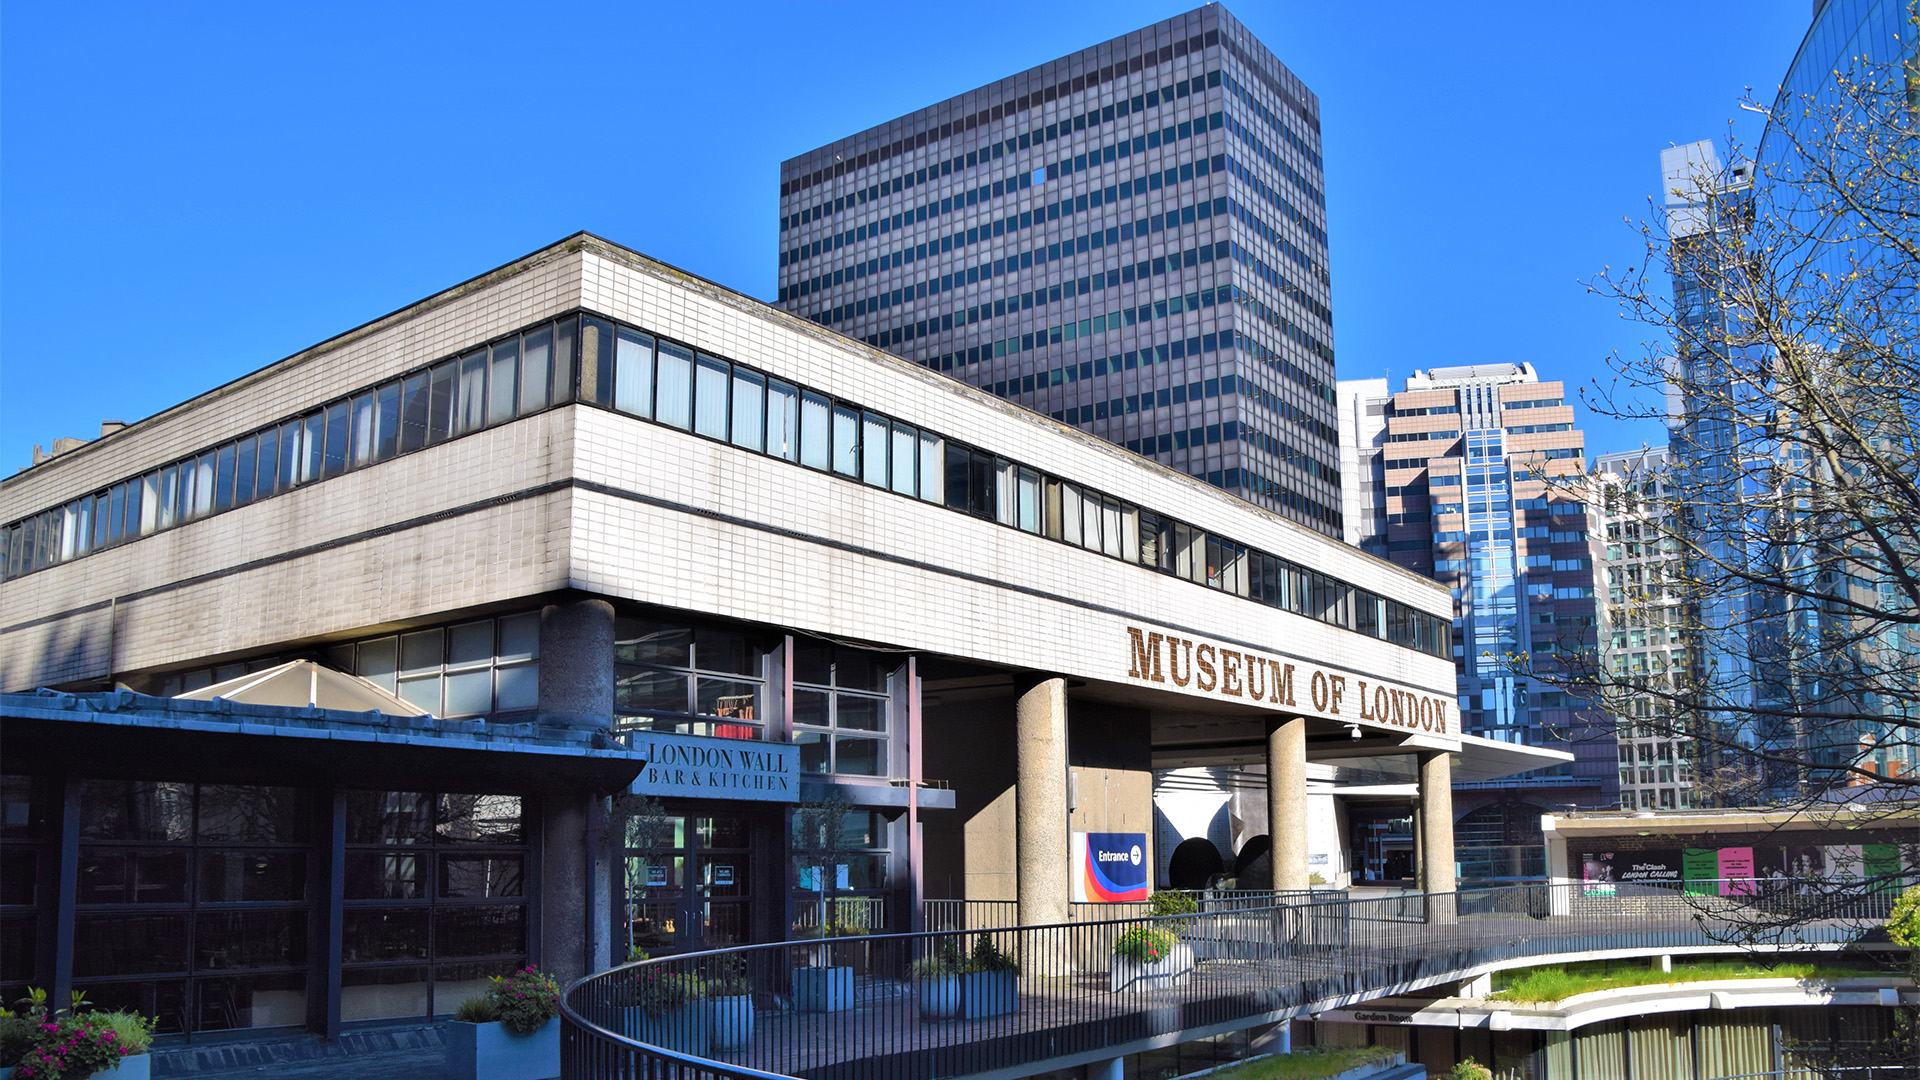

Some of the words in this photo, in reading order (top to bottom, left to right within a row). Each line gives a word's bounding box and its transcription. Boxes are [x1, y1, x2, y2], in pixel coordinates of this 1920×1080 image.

[1127, 626, 1296, 707] MUSEUM
[1311, 670, 1346, 714] OF
[1358, 681, 1447, 734] LONDON
[649, 743, 733, 769] LONDON
[739, 750, 788, 773] WALL
[649, 768, 685, 785] BAR
[691, 772, 702, 787] &
[709, 772, 788, 791] KITCHEN
[1098, 850, 1129, 862] Entrance
[1646, 863, 1666, 871] Clash
[1621, 871, 1649, 879] LONDON
[1649, 870, 1678, 878] CALLING
[1354, 1012, 1387, 1022] Garden
[1388, 1014, 1414, 1023] Room
